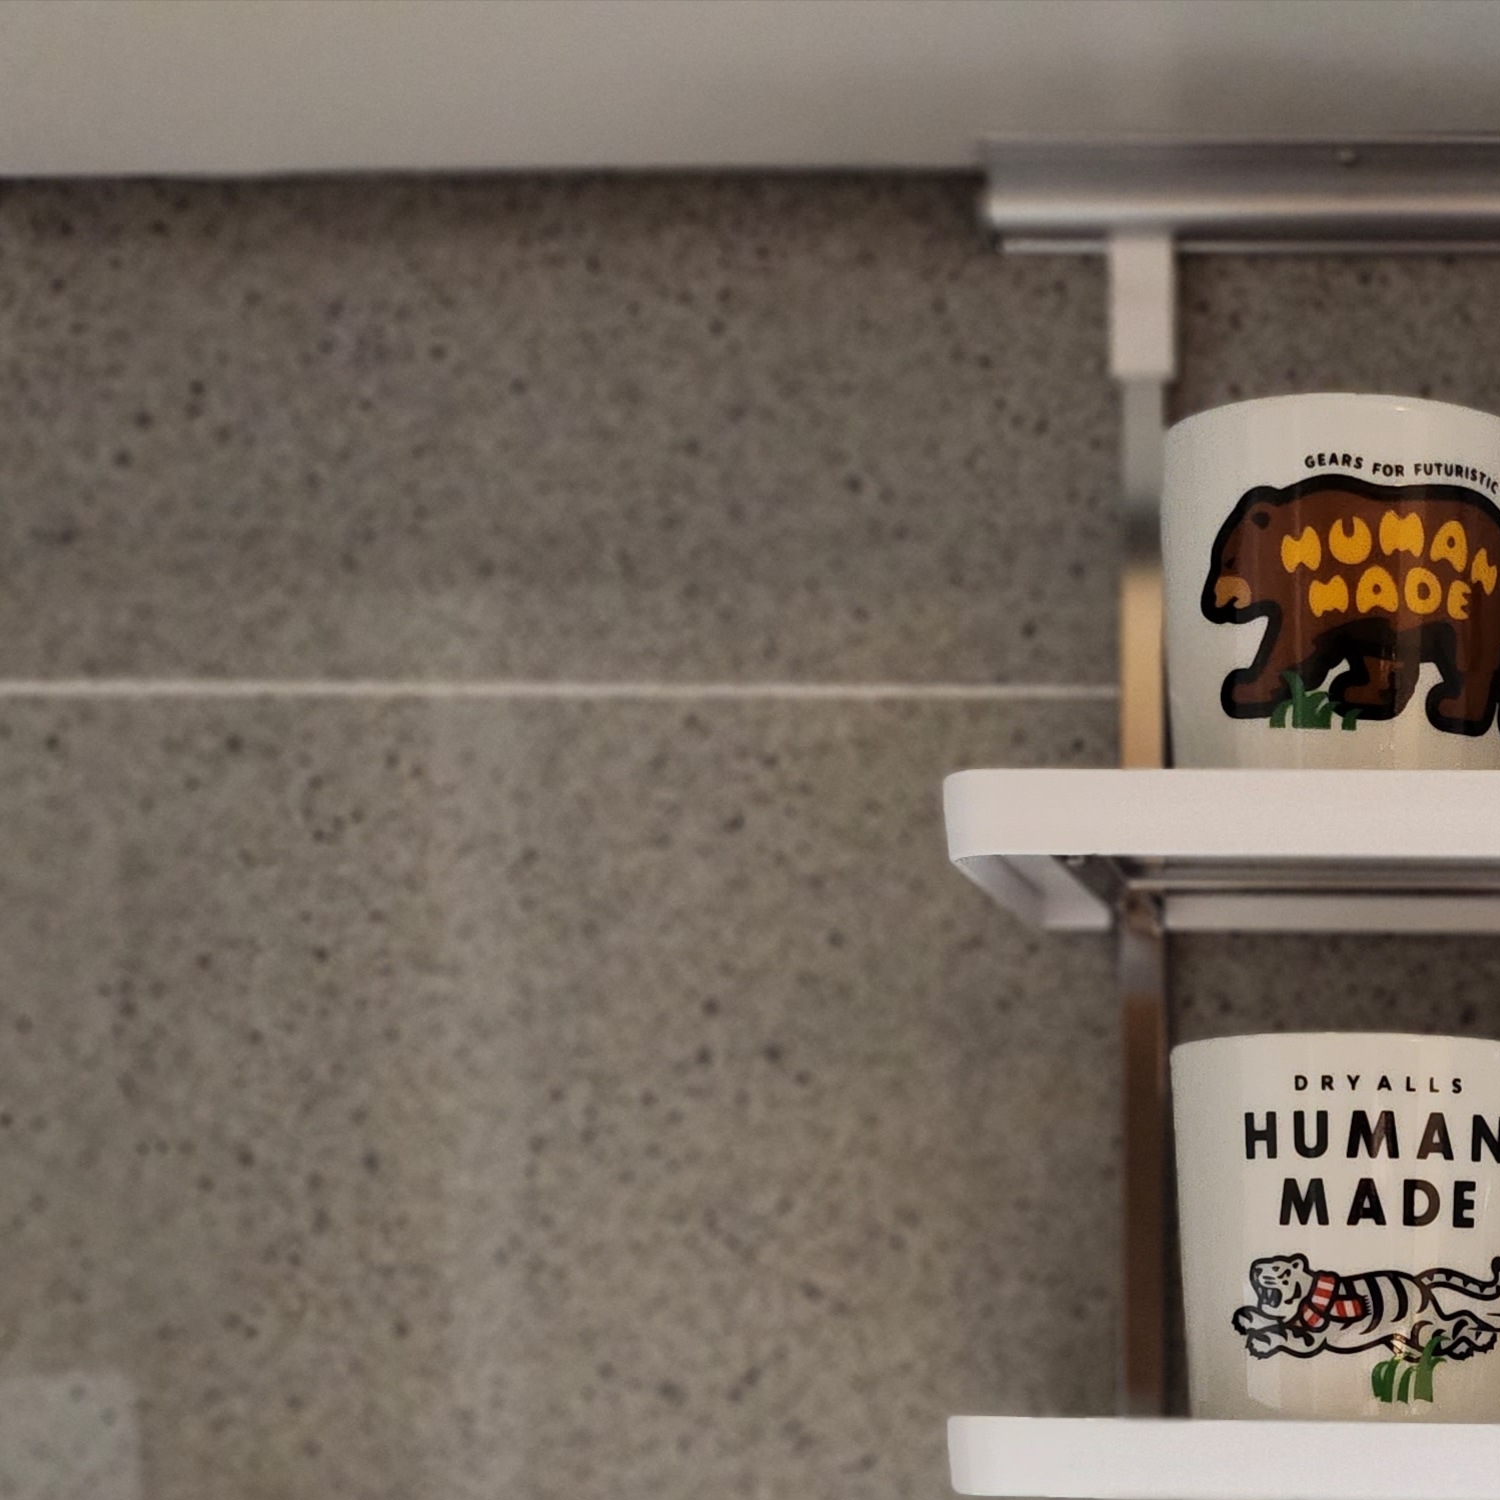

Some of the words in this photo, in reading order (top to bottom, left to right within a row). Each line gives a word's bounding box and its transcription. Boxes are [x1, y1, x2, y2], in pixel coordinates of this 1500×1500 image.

[1304, 452, 1364, 469] GEARS
[1372, 462, 1405, 477] FOR
[1414, 462, 1499, 494] FUTURISTIC
[1281, 510, 1498, 596] HUMAN
[1309, 565, 1472, 620] MADE
[1279, 1177, 1476, 1228] MADE
